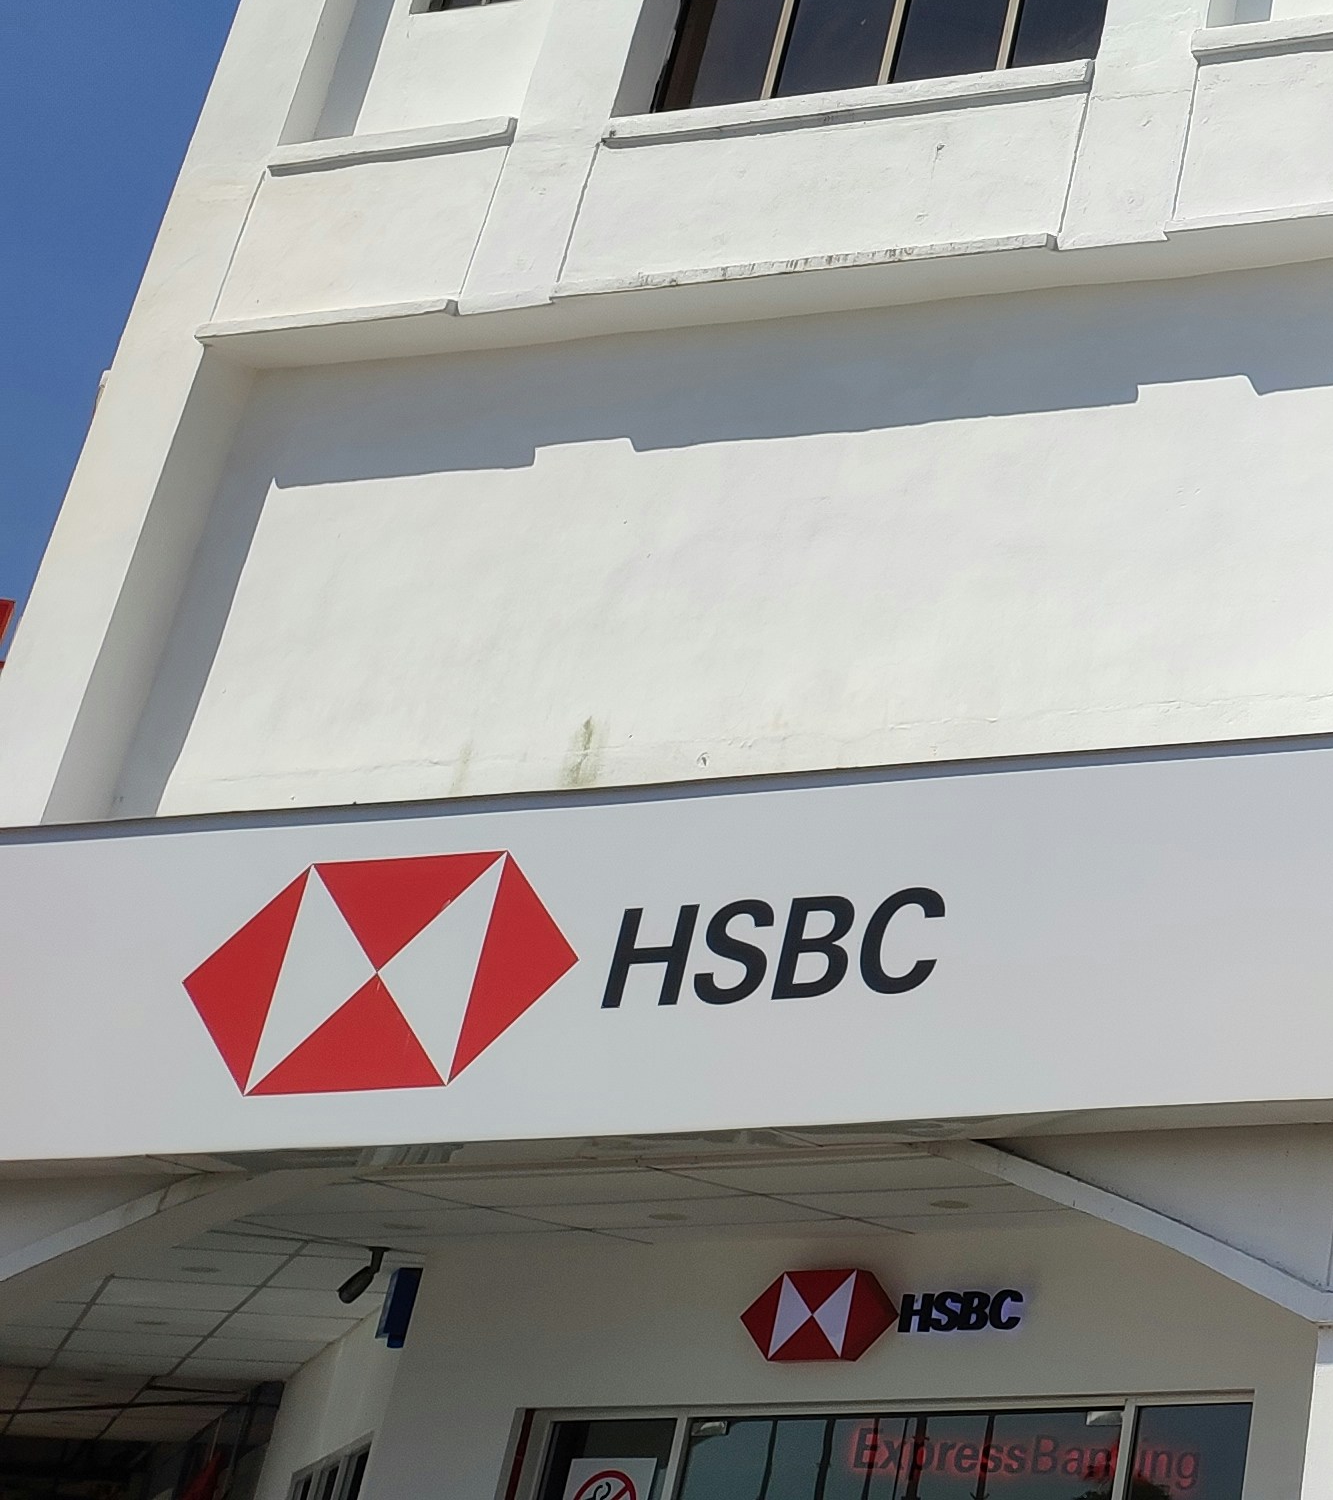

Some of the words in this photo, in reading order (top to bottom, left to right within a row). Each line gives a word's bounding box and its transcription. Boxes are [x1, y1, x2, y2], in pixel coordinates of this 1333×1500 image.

[601, 887, 946, 1008] HSBC
[897, 1289, 1023, 1332] HSBC
[853, 1427, 1199, 1489] ExpressBaning
